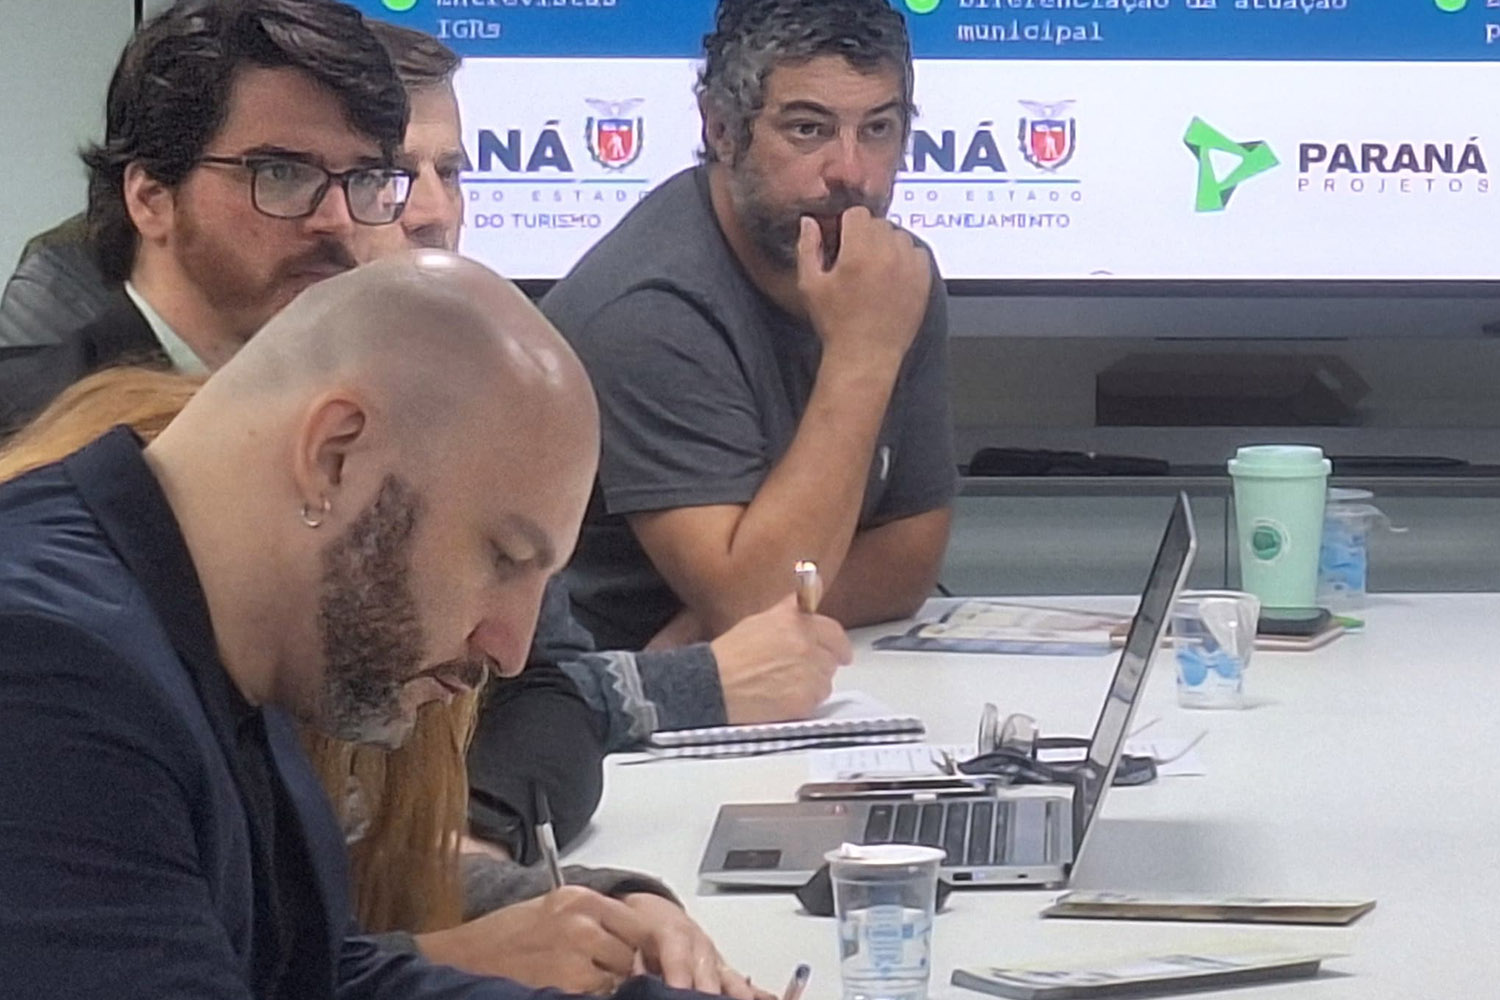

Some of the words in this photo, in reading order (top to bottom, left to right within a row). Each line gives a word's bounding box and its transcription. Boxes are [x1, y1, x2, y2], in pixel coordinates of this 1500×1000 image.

[957, 19, 1102, 45] municipal
[1299, 136, 1487, 174] PARANÁ
[1298, 178, 1489, 193] PROJETOS
[470, 190, 503, 202] DO
[905, 190, 938, 202] DO
[966, 190, 1081, 202] ESTADO
[475, 214, 504, 228] DO
[512, 214, 601, 228] TURISMO
[910, 214, 1070, 228] PLANEJAMENTO
